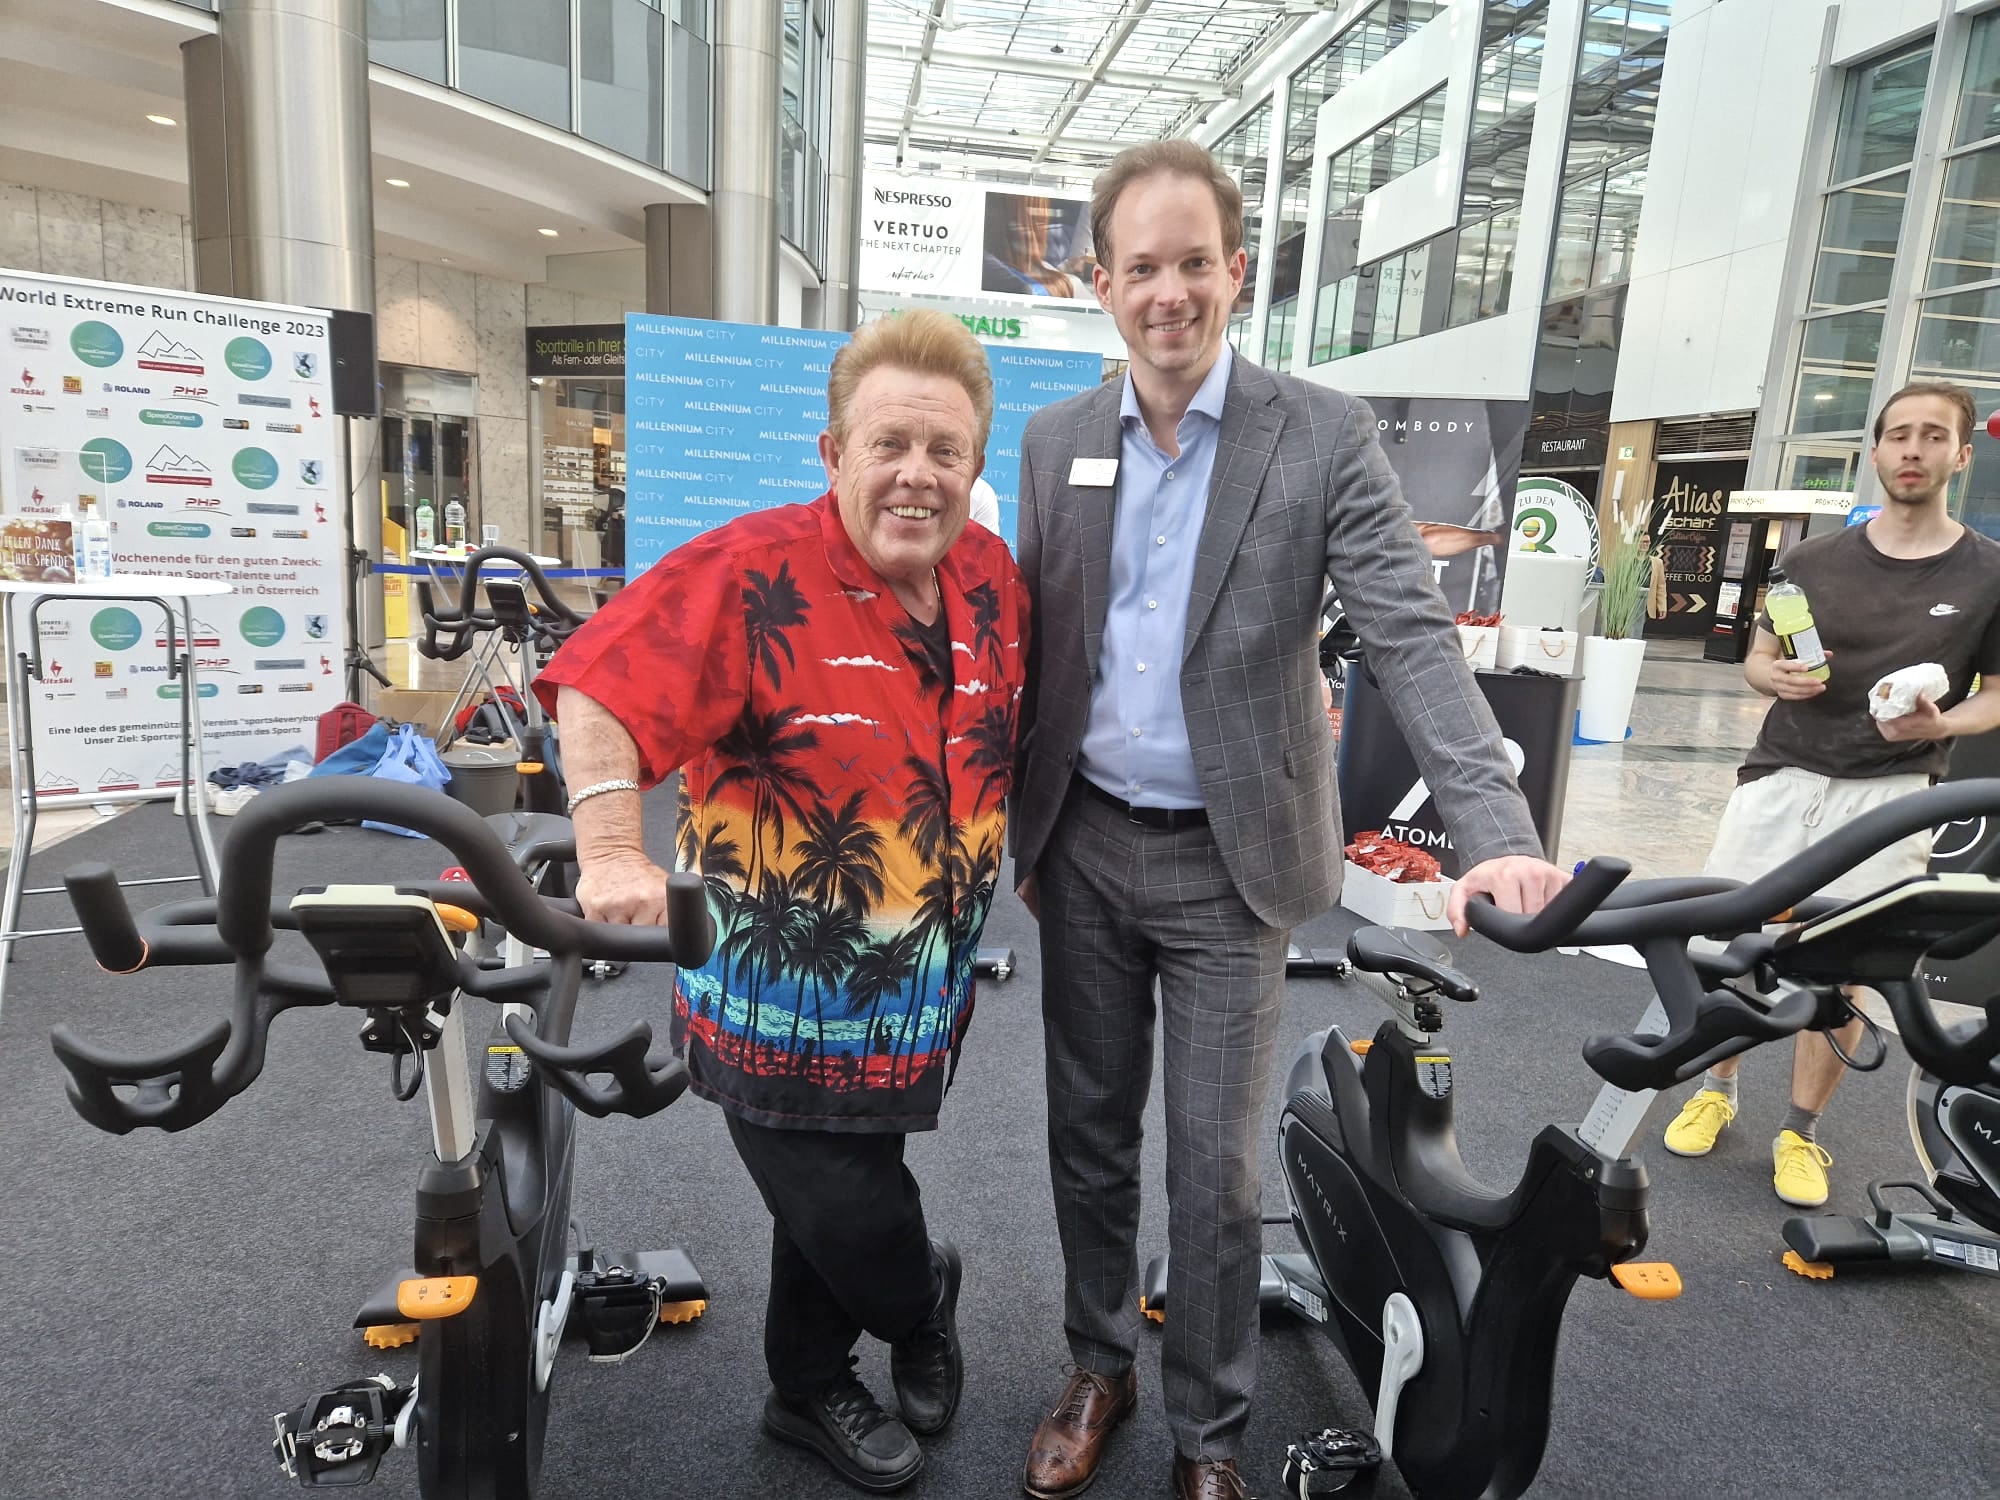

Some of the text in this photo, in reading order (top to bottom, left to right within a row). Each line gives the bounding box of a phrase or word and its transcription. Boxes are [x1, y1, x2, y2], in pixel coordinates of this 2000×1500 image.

[874, 187, 951, 208] NESPRESSO
[874, 220, 949, 239] VERTUO
[860, 238, 961, 255] THE NEXT CHAPTER
[0, 286, 325, 338] World Extreme Run Challenge 2023
[635, 323, 736, 340] MILLENNIUM CITY
[961, 316, 1021, 338] HAUS
[535, 337, 621, 356] Sportbrille in Ihrer
[761, 336, 827, 349] MILLENNIUM
[551, 353, 625, 365] Als Fern- oder Gleits
[635, 347, 784, 369] CITY MILLENNIUM CITY
[1001, 355, 1094, 369] MILLENNIUM CITY
[635, 372, 736, 389] MILLENNIUM CITY
[993, 377, 1012, 385] ITY
[1030, 381, 1091, 393] MILLENNIUM
[114, 385, 150, 394] ROLAND
[173, 385, 208, 396] PHP
[760, 383, 826, 397] MILLENNIUM
[634, 396, 783, 416] CITY MILLENNIUM CITY
[998, 401, 1043, 412] MILLENN
[635, 420, 735, 436] MILLENNIUM CITY
[991, 424, 1010, 433] ITY
[1378, 419, 1474, 433] OMBODY
[759, 431, 819, 443] MILLENNIU
[1541, 438, 1587, 453] RESTAURANT
[634, 444, 782, 463] CITY MILLENNIUM CITY
[635, 468, 734, 483] MILLENNIUM CITY
[759, 478, 823, 490] MILLENNIUM
[185, 497, 221, 507] PHP
[634, 491, 665, 502] CITY
[683, 495, 750, 508] MILLENNIUM
[1518, 495, 1556, 507] ZU DEN
[1662, 475, 1723, 515] Alias
[128, 500, 163, 509] ROLAND
[635, 515, 702, 528] MILLENNIUM
[4, 535, 62, 551] IELEN DANK
[634, 537, 664, 548] CITY
[35, 551, 69, 568] SPENDE
[195, 553, 214, 565] für
[217, 554, 241, 565] den
[243, 556, 278, 568] guten
[281, 556, 322, 567] Zweck:
[187, 569, 270, 580] Sport-Talente
[273, 570, 296, 581] und
[1665, 573, 1712, 583] FFEE TO GO
[242, 585, 253, 595] in
[257, 583, 319, 595] Österreich
[194, 658, 230, 667] PHP
[49, 727, 71, 736] Eine
[73, 725, 97, 735] Idee
[99, 723, 117, 733] des
[202, 718, 238, 728] Vereins
[240, 714, 321, 726] "sports4everybod
[84, 736, 114, 745] Unser
[116, 734, 138, 744] Ziel:
[203, 729, 249, 740] zugunsten
[251, 727, 269, 737] des
[271, 725, 301, 736] Sports
[1380, 824, 1455, 849] ATOM
[1924, 973, 1948, 983] E.AT
[1298, 1153, 1347, 1243] MATRIX
